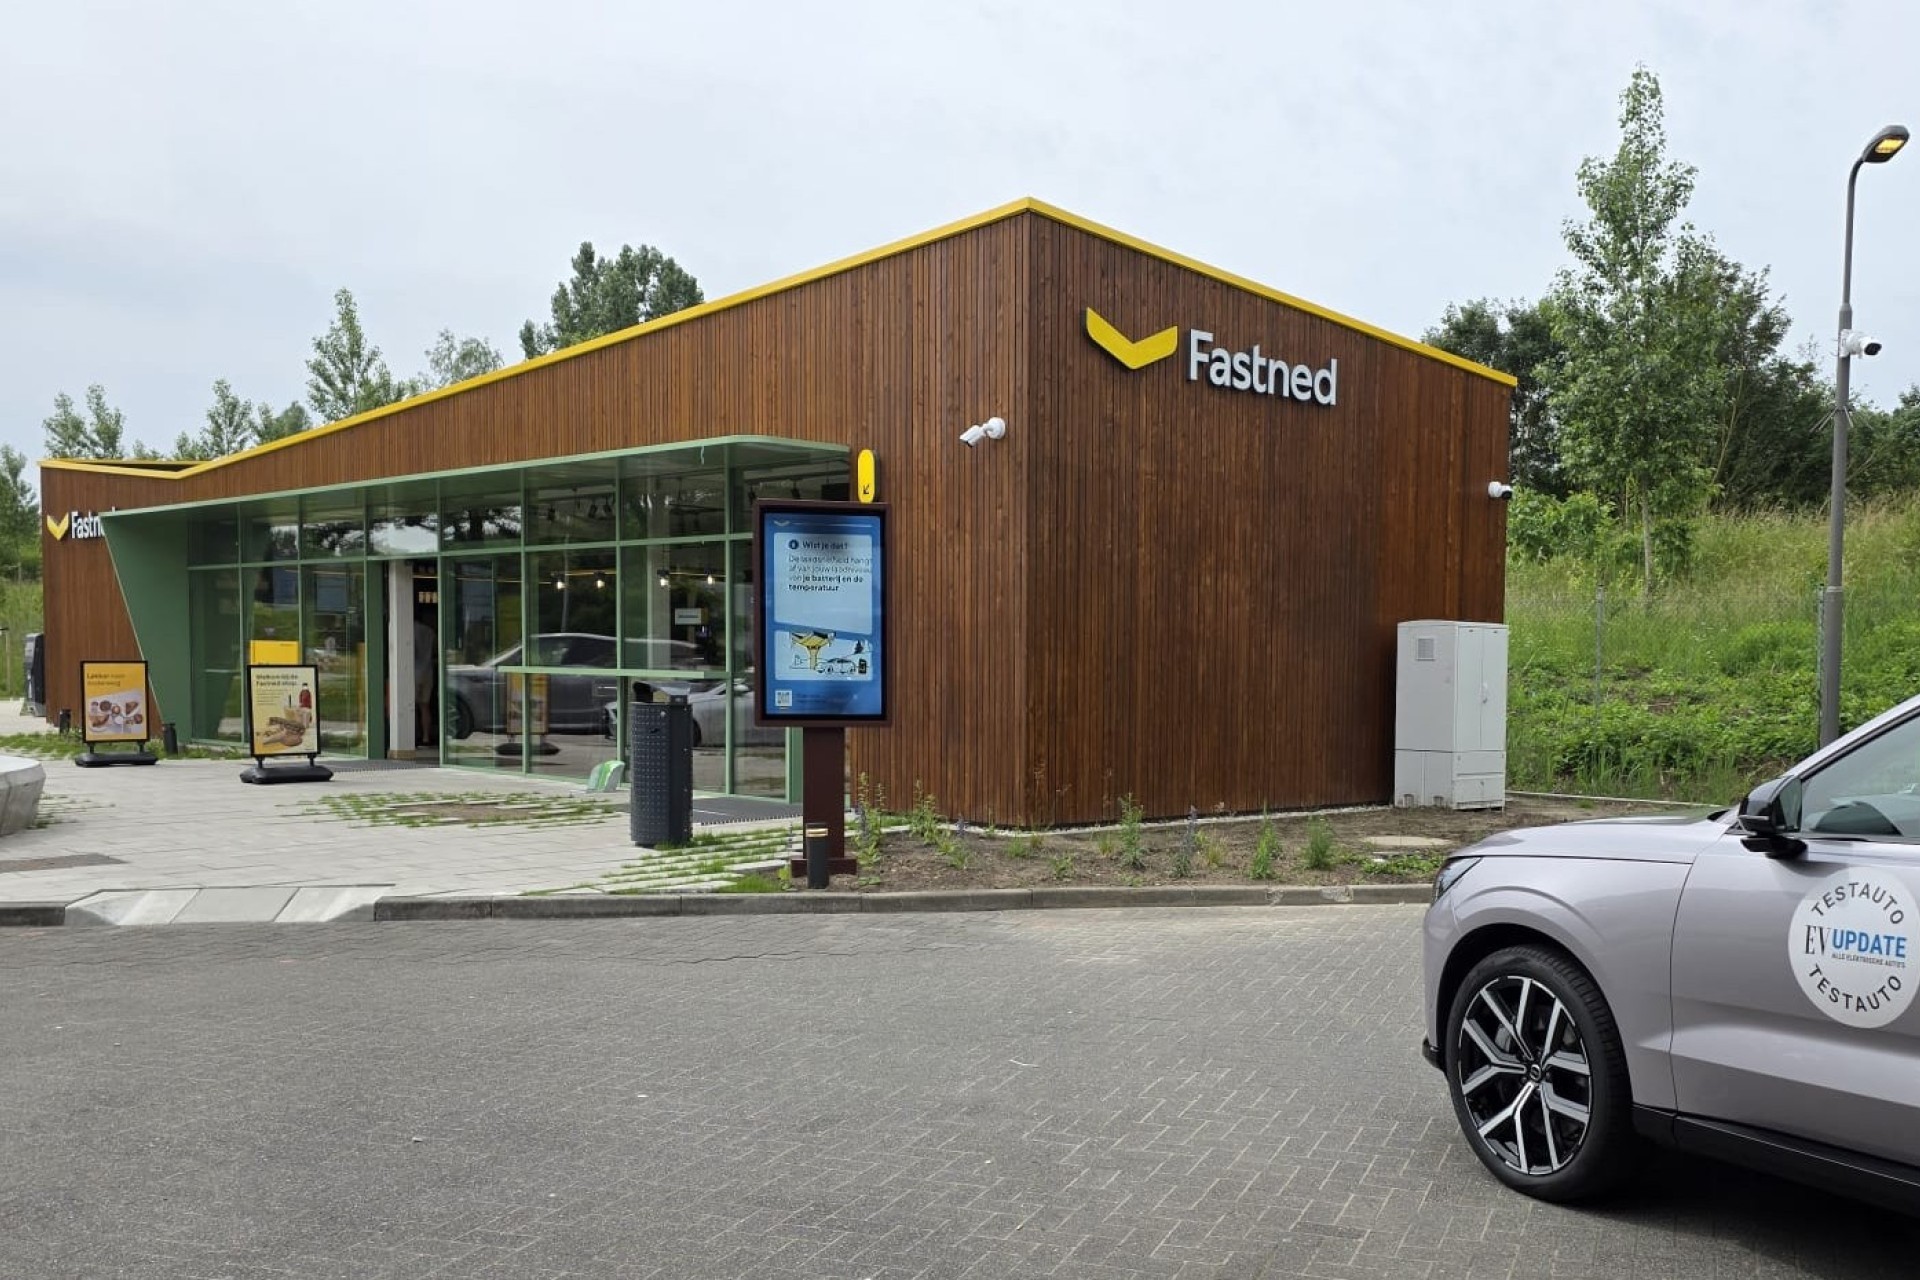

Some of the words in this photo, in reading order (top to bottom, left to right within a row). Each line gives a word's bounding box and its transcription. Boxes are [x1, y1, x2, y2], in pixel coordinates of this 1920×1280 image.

[1189, 328, 1338, 406] Fastned
[71, 506, 115, 539] Fastn
[802, 540, 820, 550] Wist
[821, 542, 829, 551] je
[811, 574, 841, 584] batterij
[853, 575, 863, 583] de
[1811, 882, 1905, 925] TESTAUTO
[1805, 924, 1831, 956] EV
[1831, 928, 1908, 959] UPDATE
[1809, 963, 1902, 1013] TESTAUTO
